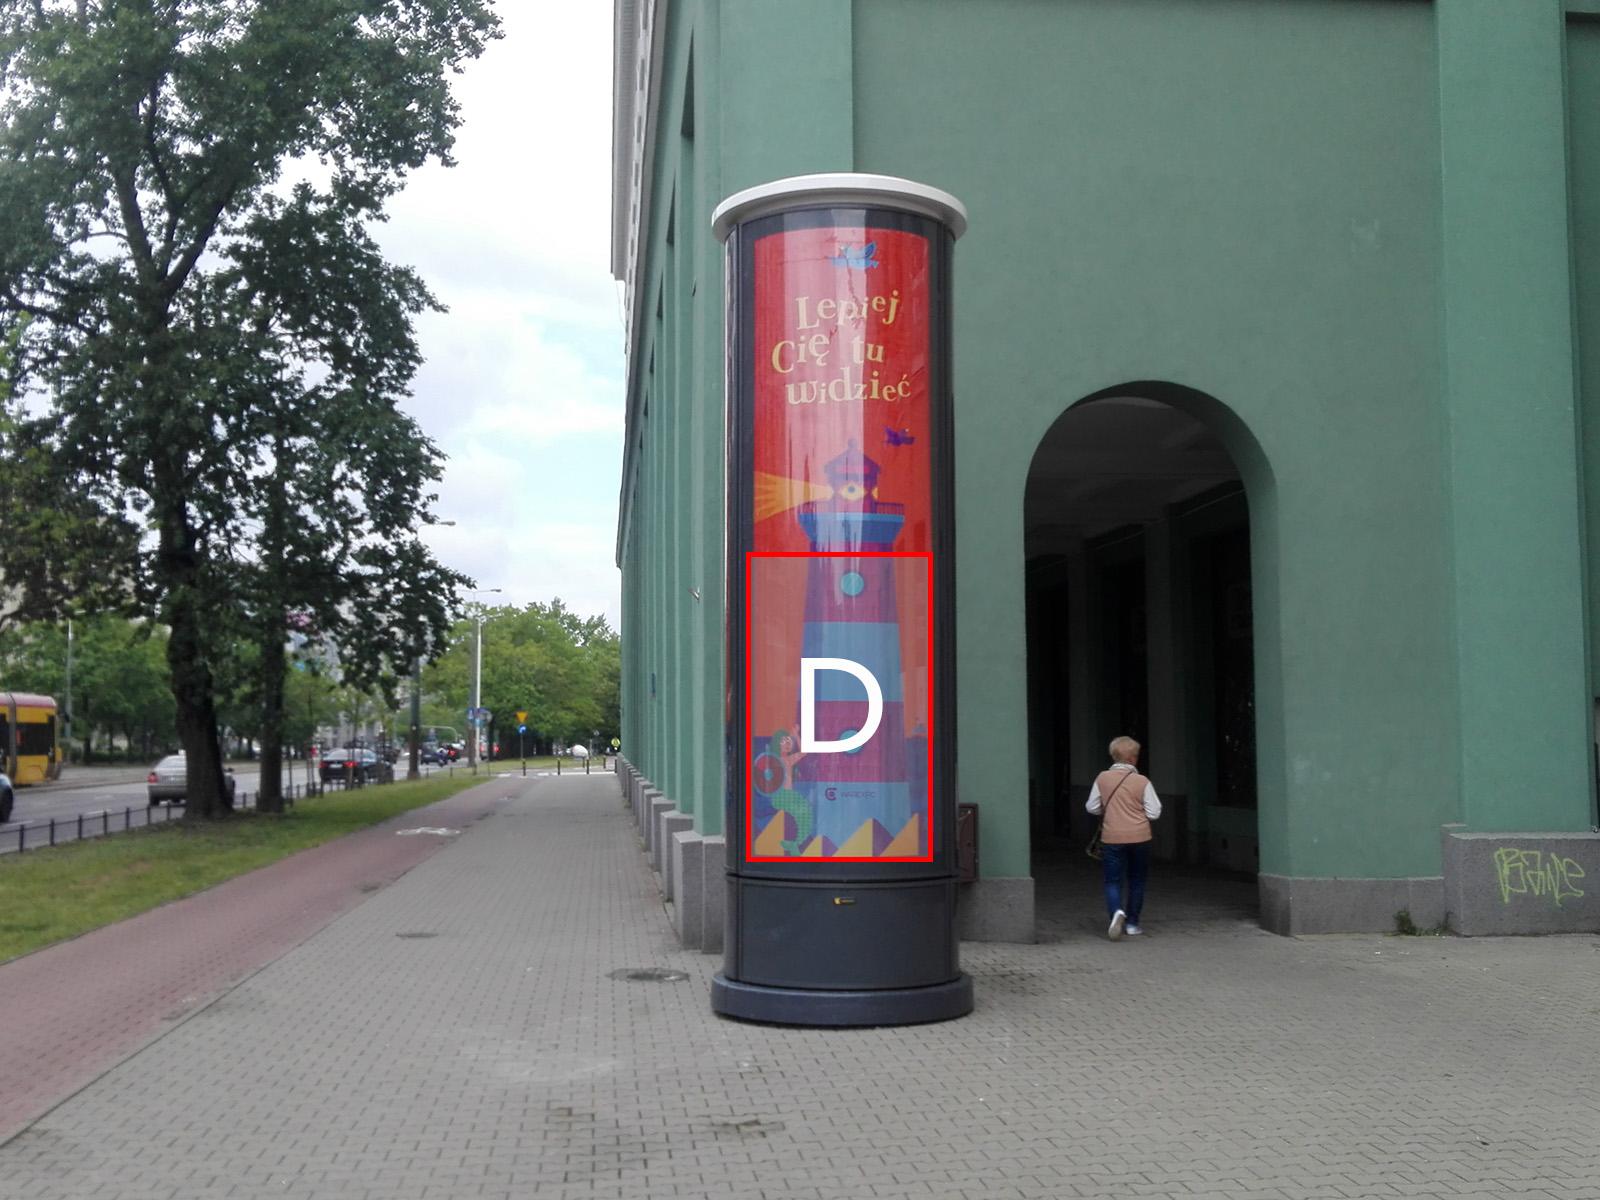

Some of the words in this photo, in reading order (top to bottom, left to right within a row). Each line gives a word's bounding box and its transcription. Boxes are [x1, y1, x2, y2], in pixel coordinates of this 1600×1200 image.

[795, 290, 899, 330] Lepiej
[771, 333, 830, 374] Cię
[852, 335, 884, 365] tu
[785, 366, 911, 405] widzieć
